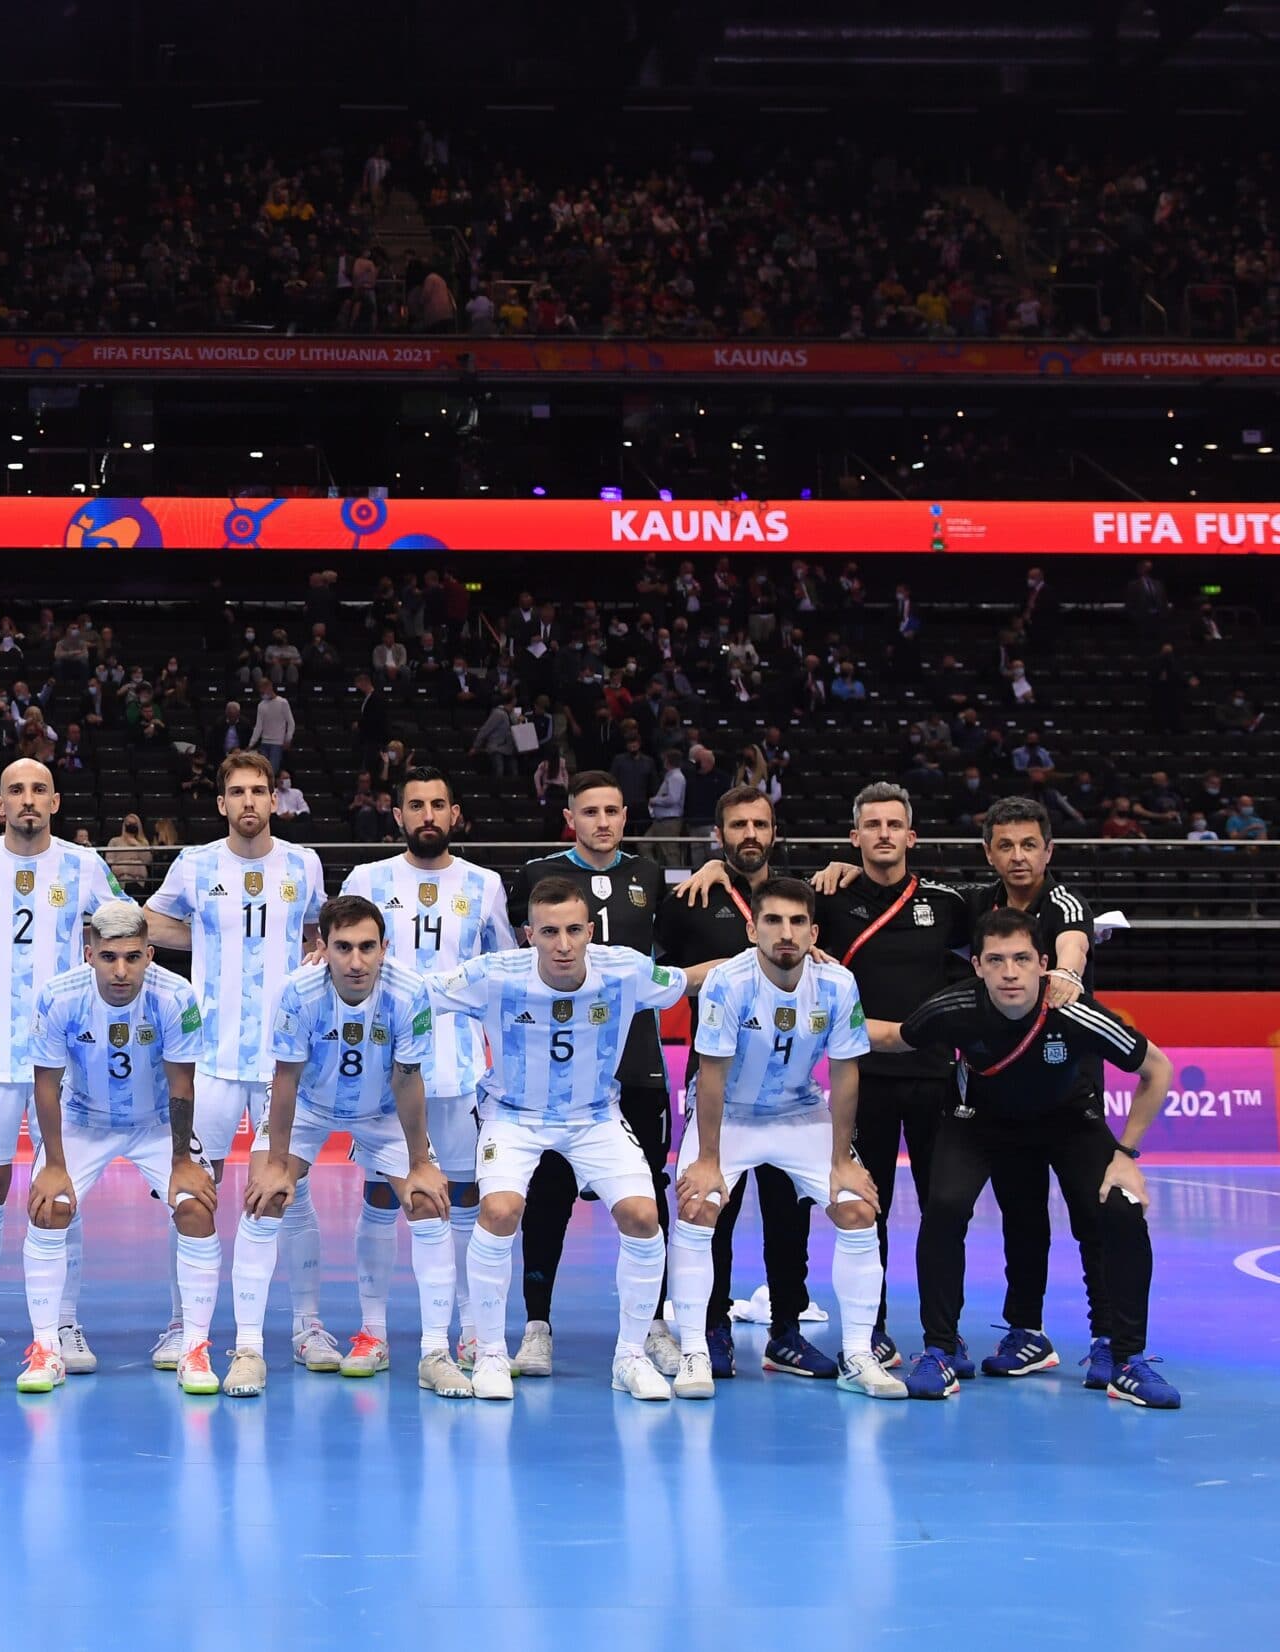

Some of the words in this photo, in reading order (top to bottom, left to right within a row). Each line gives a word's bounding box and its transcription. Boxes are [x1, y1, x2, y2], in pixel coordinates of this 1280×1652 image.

[93, 347, 129, 360] FIFA
[132, 347, 194, 361] FUTSAL
[198, 347, 259, 361] WORLD
[263, 348, 296, 361] CUP
[300, 348, 389, 361] LITHUANIA
[713, 349, 808, 366] KAUNAS
[1102, 352, 1137, 366] FIFA
[1140, 353, 1202, 367] FUTSAL
[1204, 353, 1266, 367] WORLD
[611, 509, 789, 542] KAUNAS
[1093, 512, 1183, 544] FIFA
[14, 909, 34, 944] 2
[243, 904, 267, 938] 11
[411, 916, 442, 951] 14
[597, 907, 610, 943] 1
[551, 1031, 575, 1063] 5
[774, 1036, 794, 1065] 4
[109, 1052, 132, 1080] 3
[340, 1049, 364, 1078] 8
[659, 1108, 667, 1144] 1
